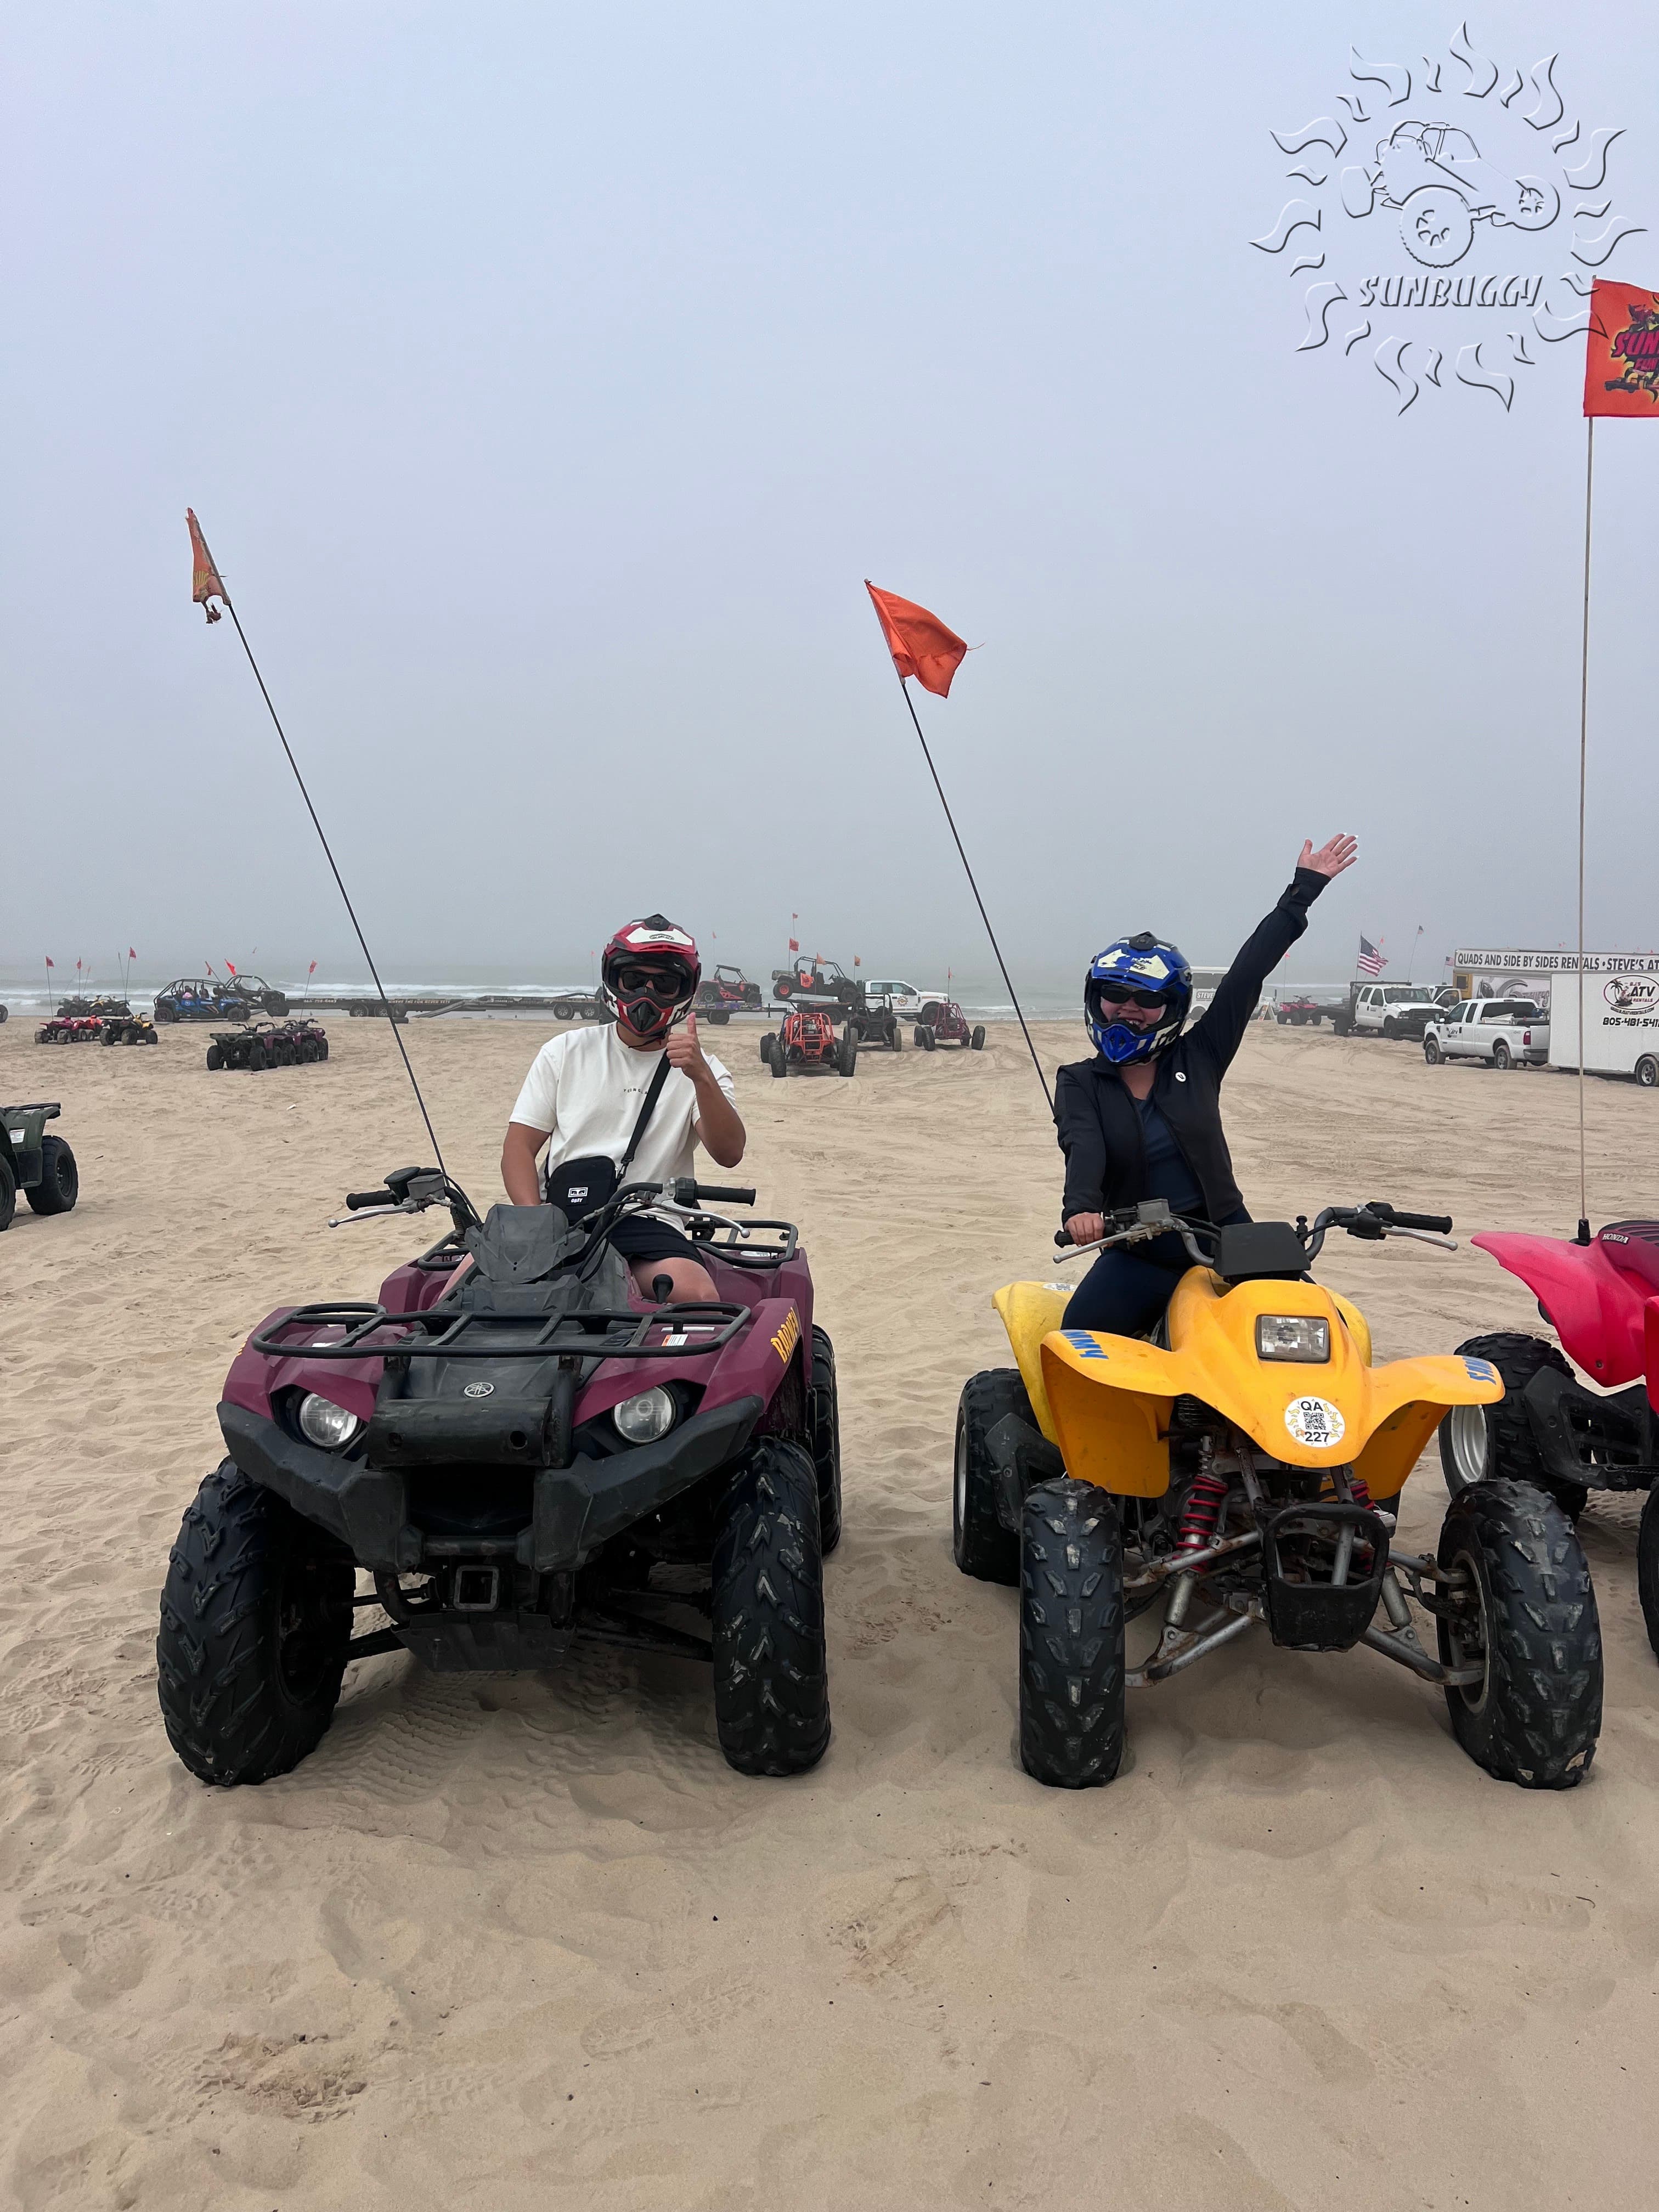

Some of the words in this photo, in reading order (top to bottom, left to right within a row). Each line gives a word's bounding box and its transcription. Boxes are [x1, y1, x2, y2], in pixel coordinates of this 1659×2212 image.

[1613, 330, 1659, 356] SUN
[1458, 953, 1483, 964] QUADS
[1484, 954, 1502, 966] AND
[1503, 955, 1521, 967] SIDE
[1523, 956, 1534, 967] BY
[1535, 956, 1559, 968] SIDES
[1561, 957, 1600, 970] RENALS
[1607, 958, 1644, 970] STEVE'S
[1630, 986, 1656, 997] ATV
[1603, 1017, 1659, 1027] 805-481-541
[1602, 1233, 1629, 1243] HONDA
[770, 1306, 799, 1364] BARNEY
[1300, 1401, 1324, 1412] QA
[1304, 1431, 1330, 1442] 227
